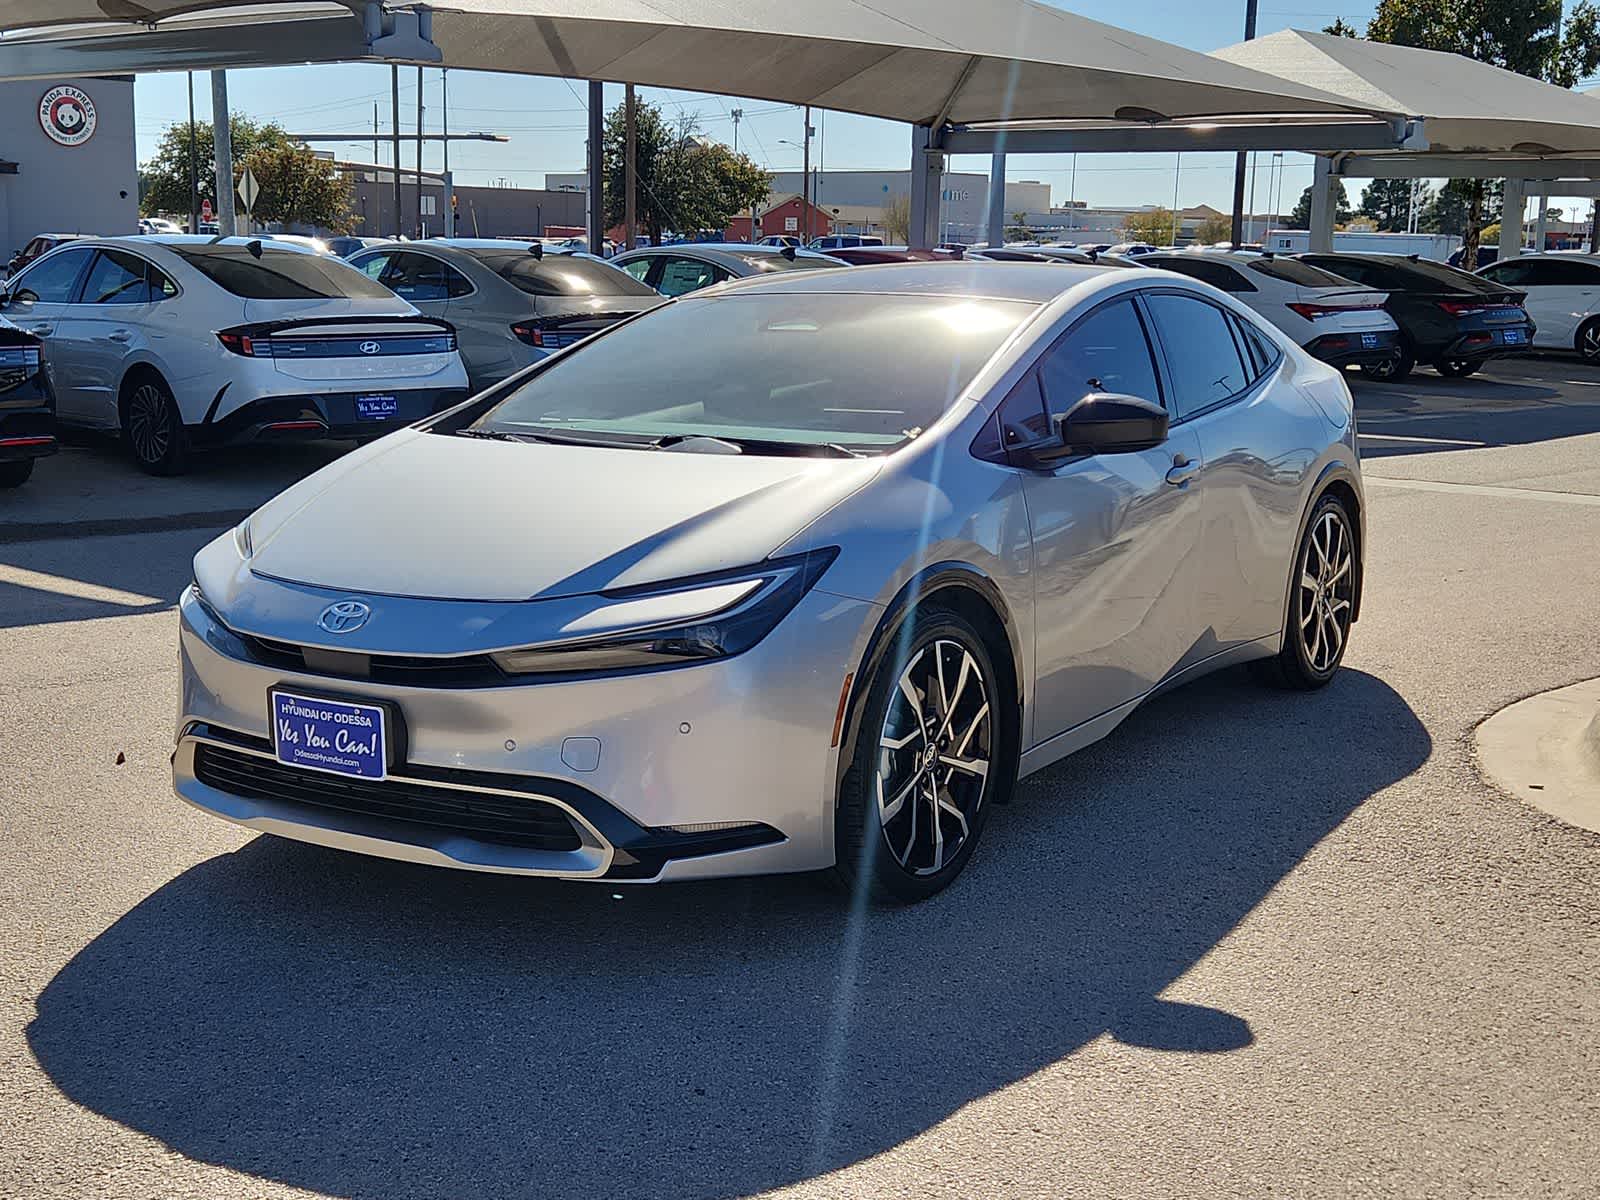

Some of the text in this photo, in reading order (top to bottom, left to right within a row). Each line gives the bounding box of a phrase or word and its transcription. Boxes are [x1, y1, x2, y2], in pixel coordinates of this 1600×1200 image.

[42, 88, 94, 118] PANDA EXPRESS
[282, 704, 372, 727] HYUNDAI OF ODESSA
[279, 719, 377, 757] Yes You Can!
[295, 749, 359, 767] OdessaHyundai.com
